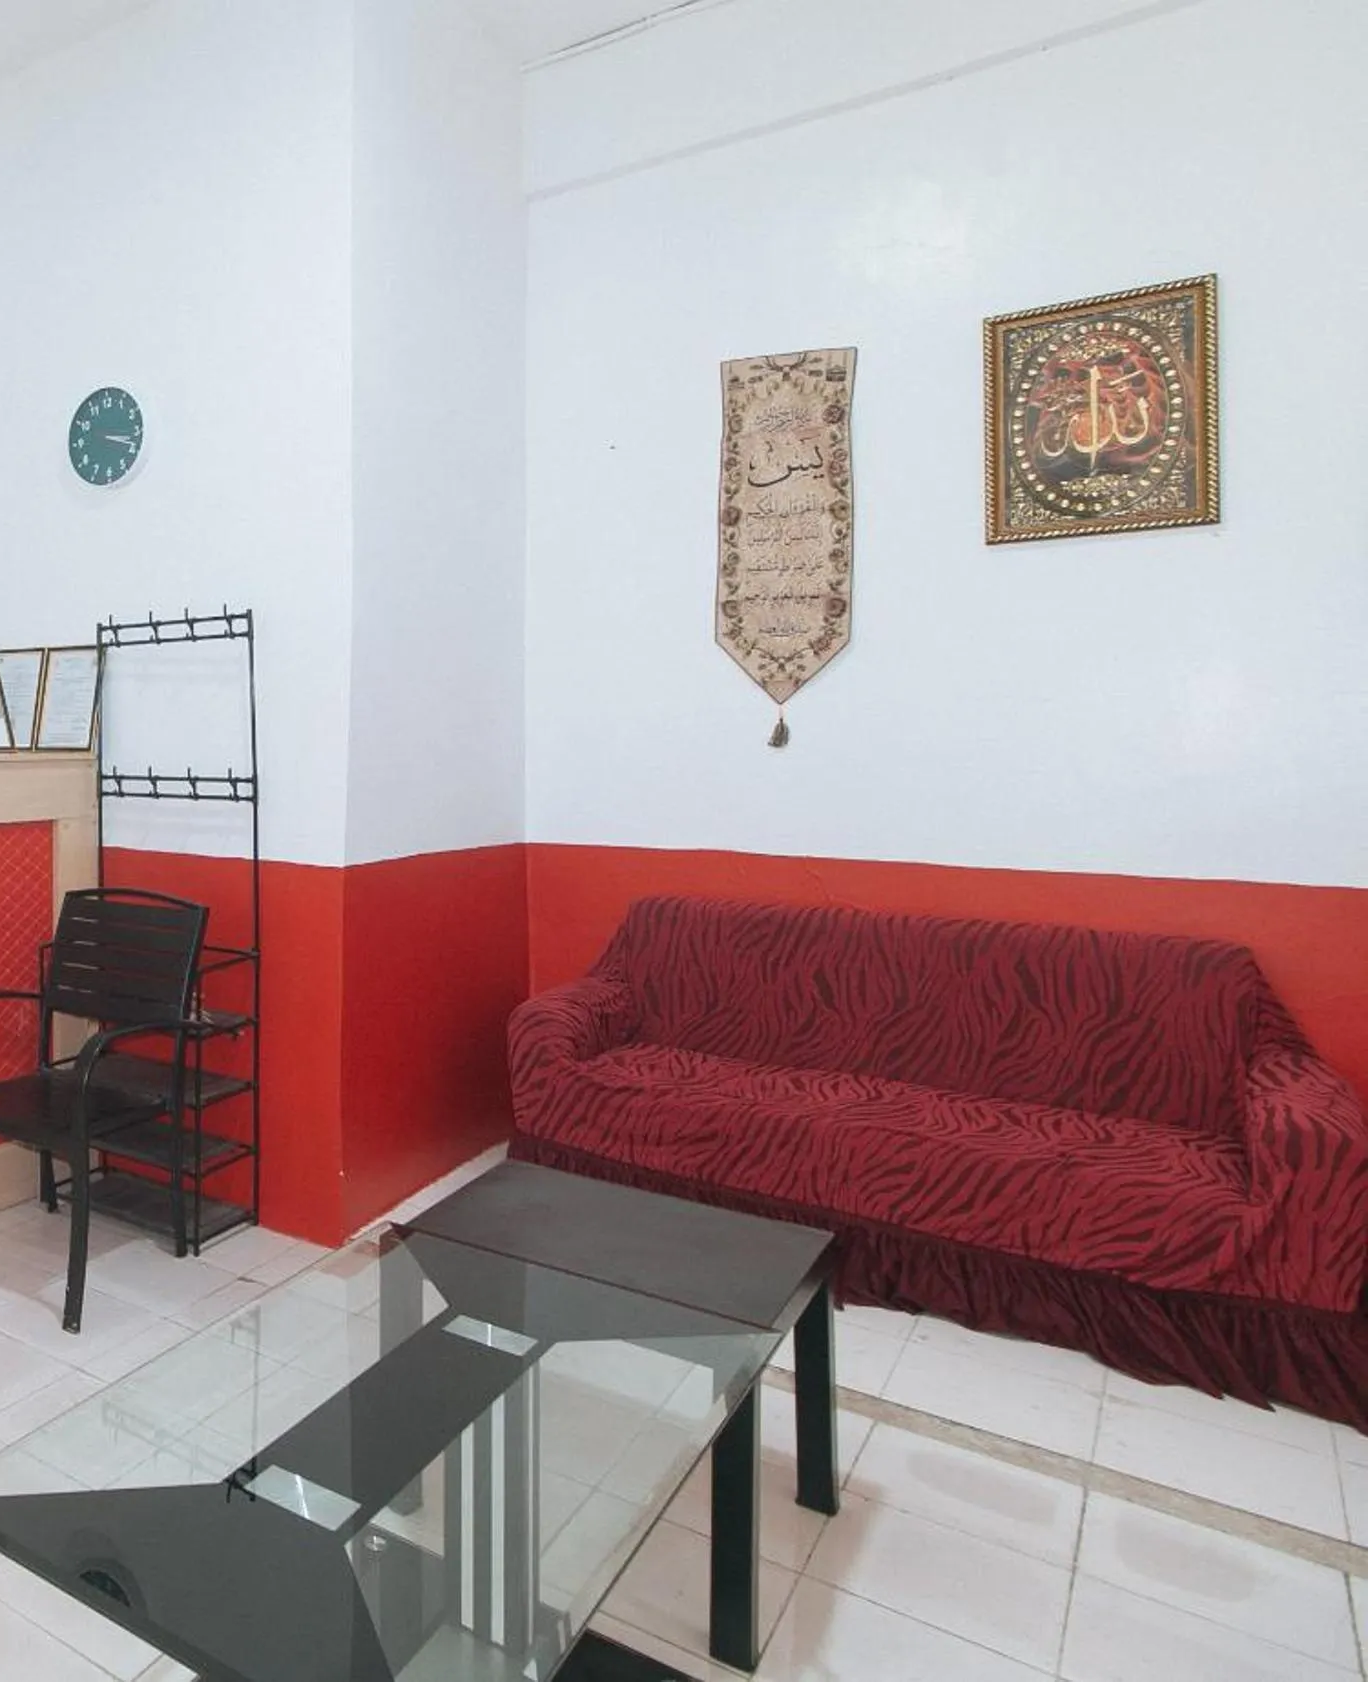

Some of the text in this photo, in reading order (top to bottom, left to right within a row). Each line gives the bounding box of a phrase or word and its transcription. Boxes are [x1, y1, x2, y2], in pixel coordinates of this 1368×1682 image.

[103, 397, 112, 408] 12
[119, 399, 124, 410] 1
[90, 405, 100, 416] 11
[128, 409, 135, 420] 2
[81, 420, 91, 432] 10
[93, 464, 100, 475] 7
[119, 458, 126, 470] 5
